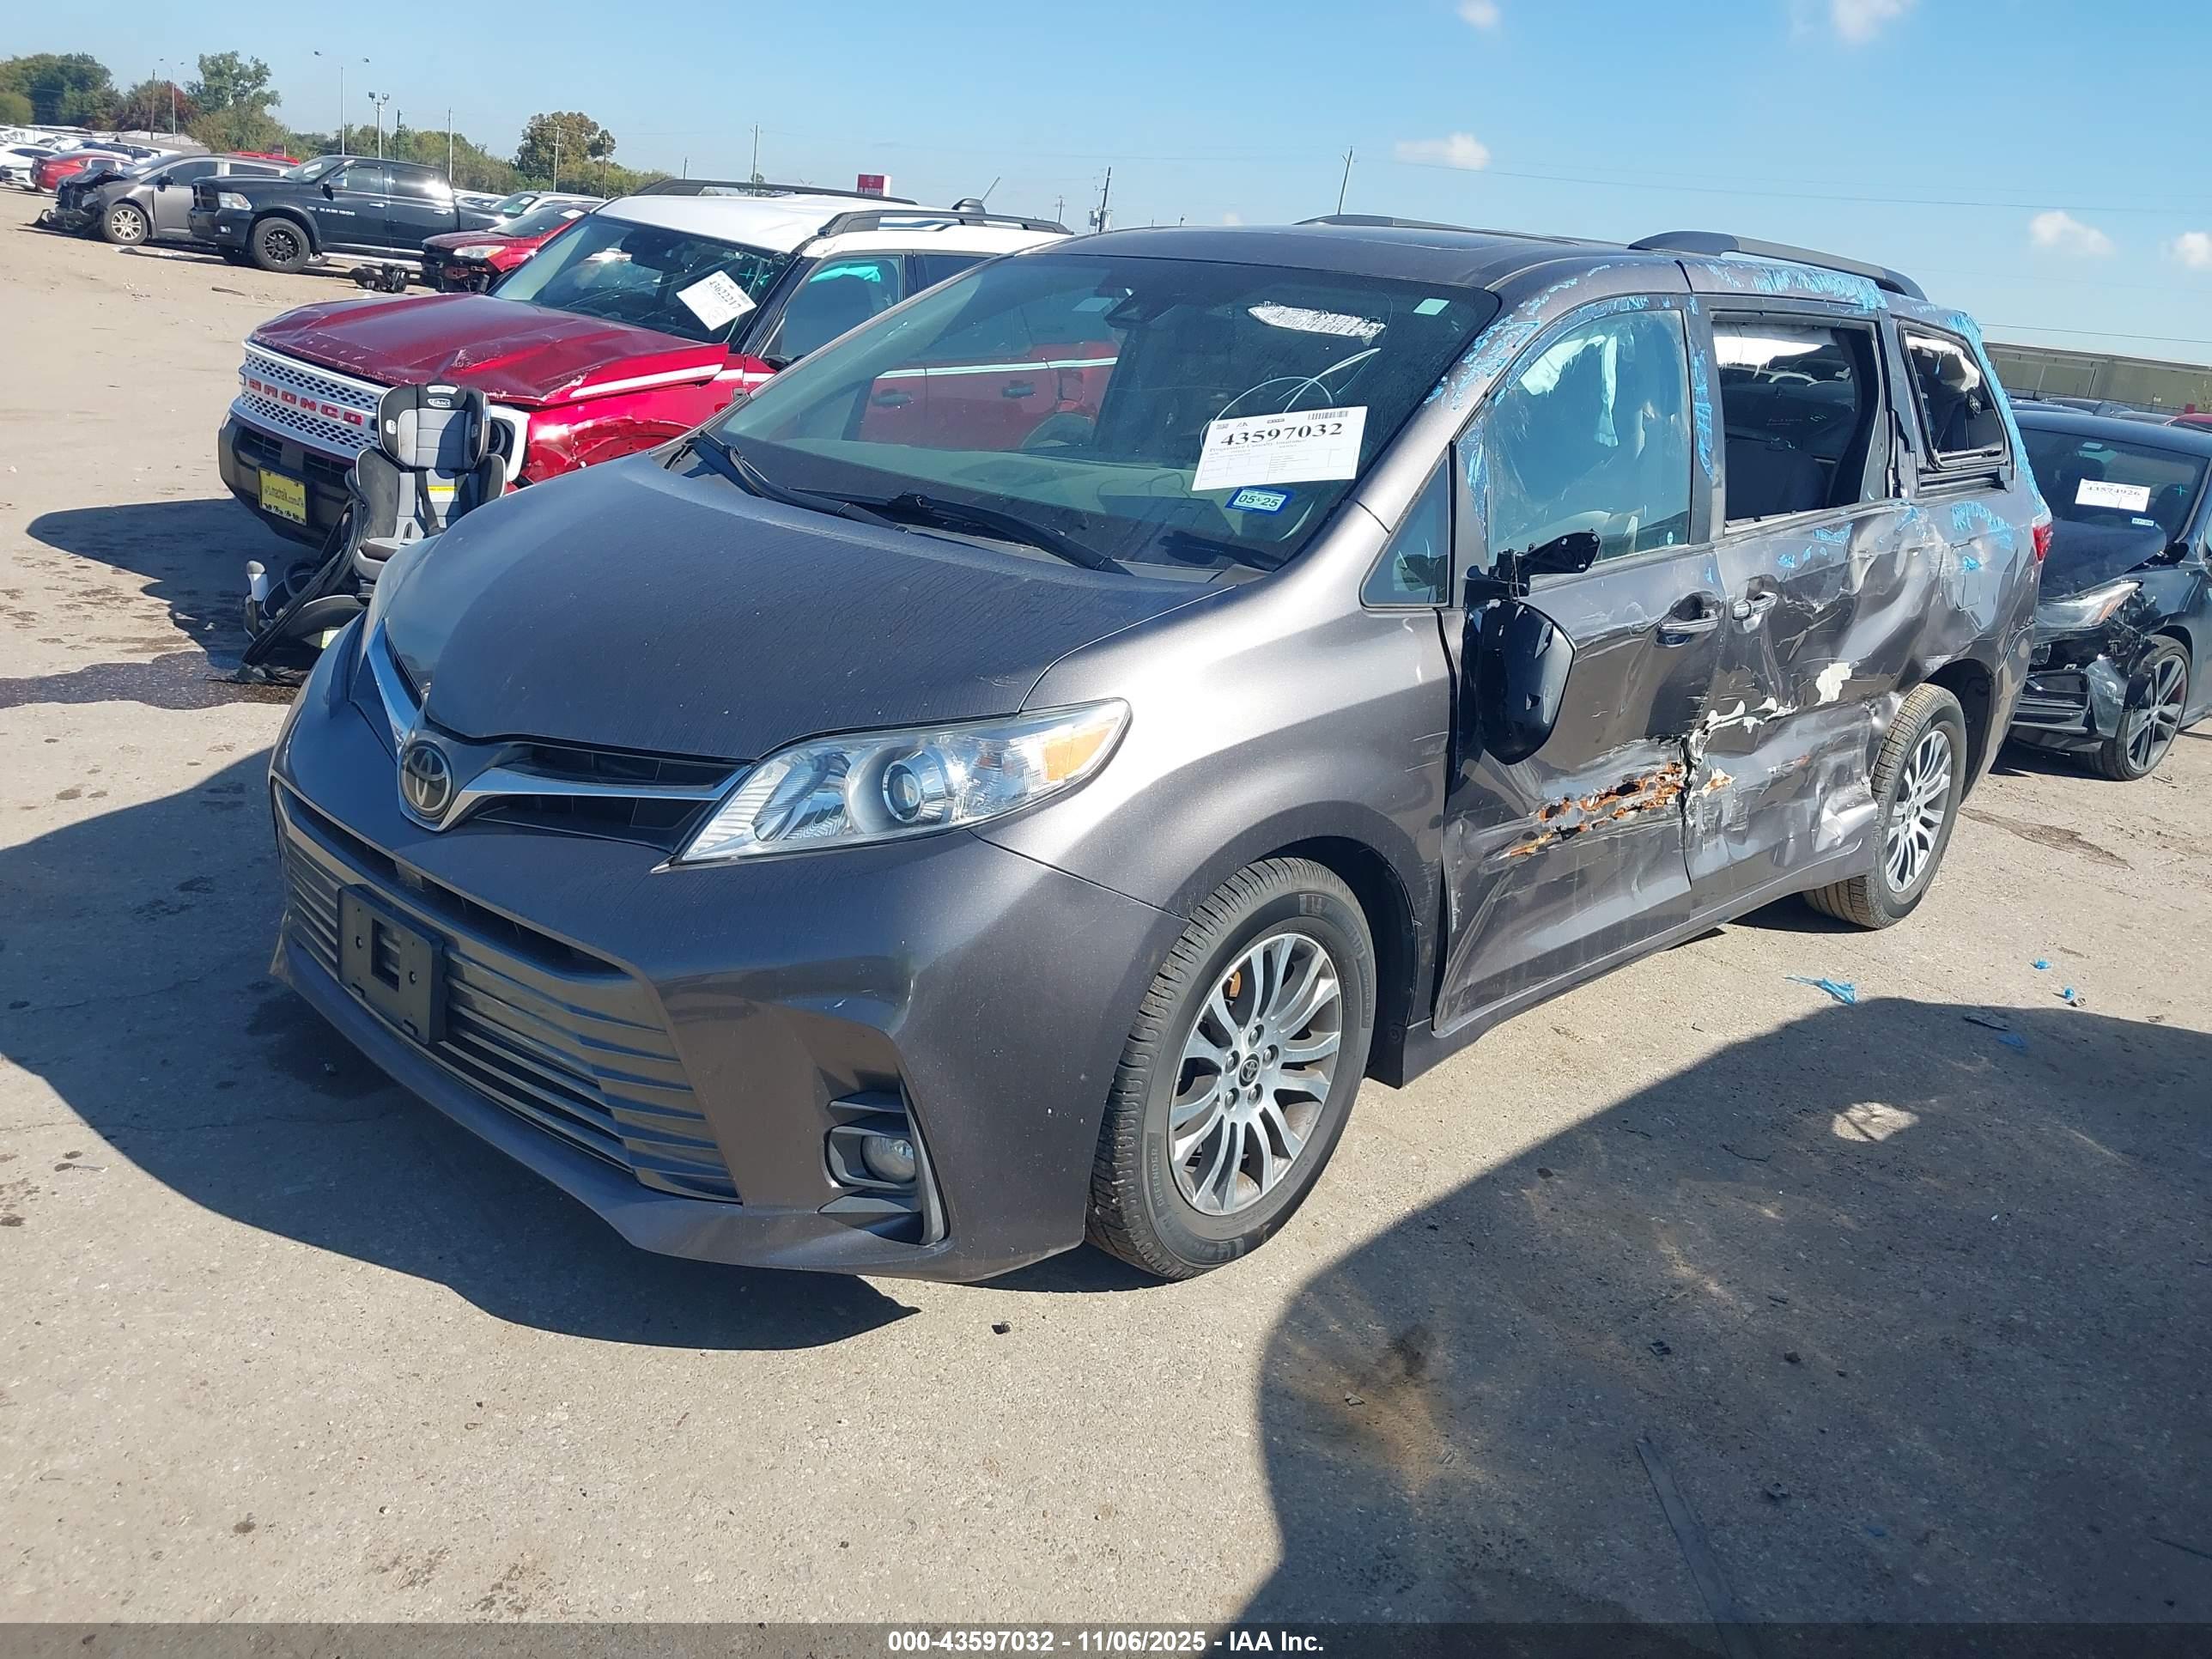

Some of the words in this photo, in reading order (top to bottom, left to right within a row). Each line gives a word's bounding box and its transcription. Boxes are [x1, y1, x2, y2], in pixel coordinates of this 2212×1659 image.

[248, 378, 364, 426] BRONCO
[1220, 422, 1343, 446] 43597032
[1238, 494, 1256, 504] 05
[1261, 497, 1280, 507] 25
[1151, 1147, 1165, 1206] DEFENDER
